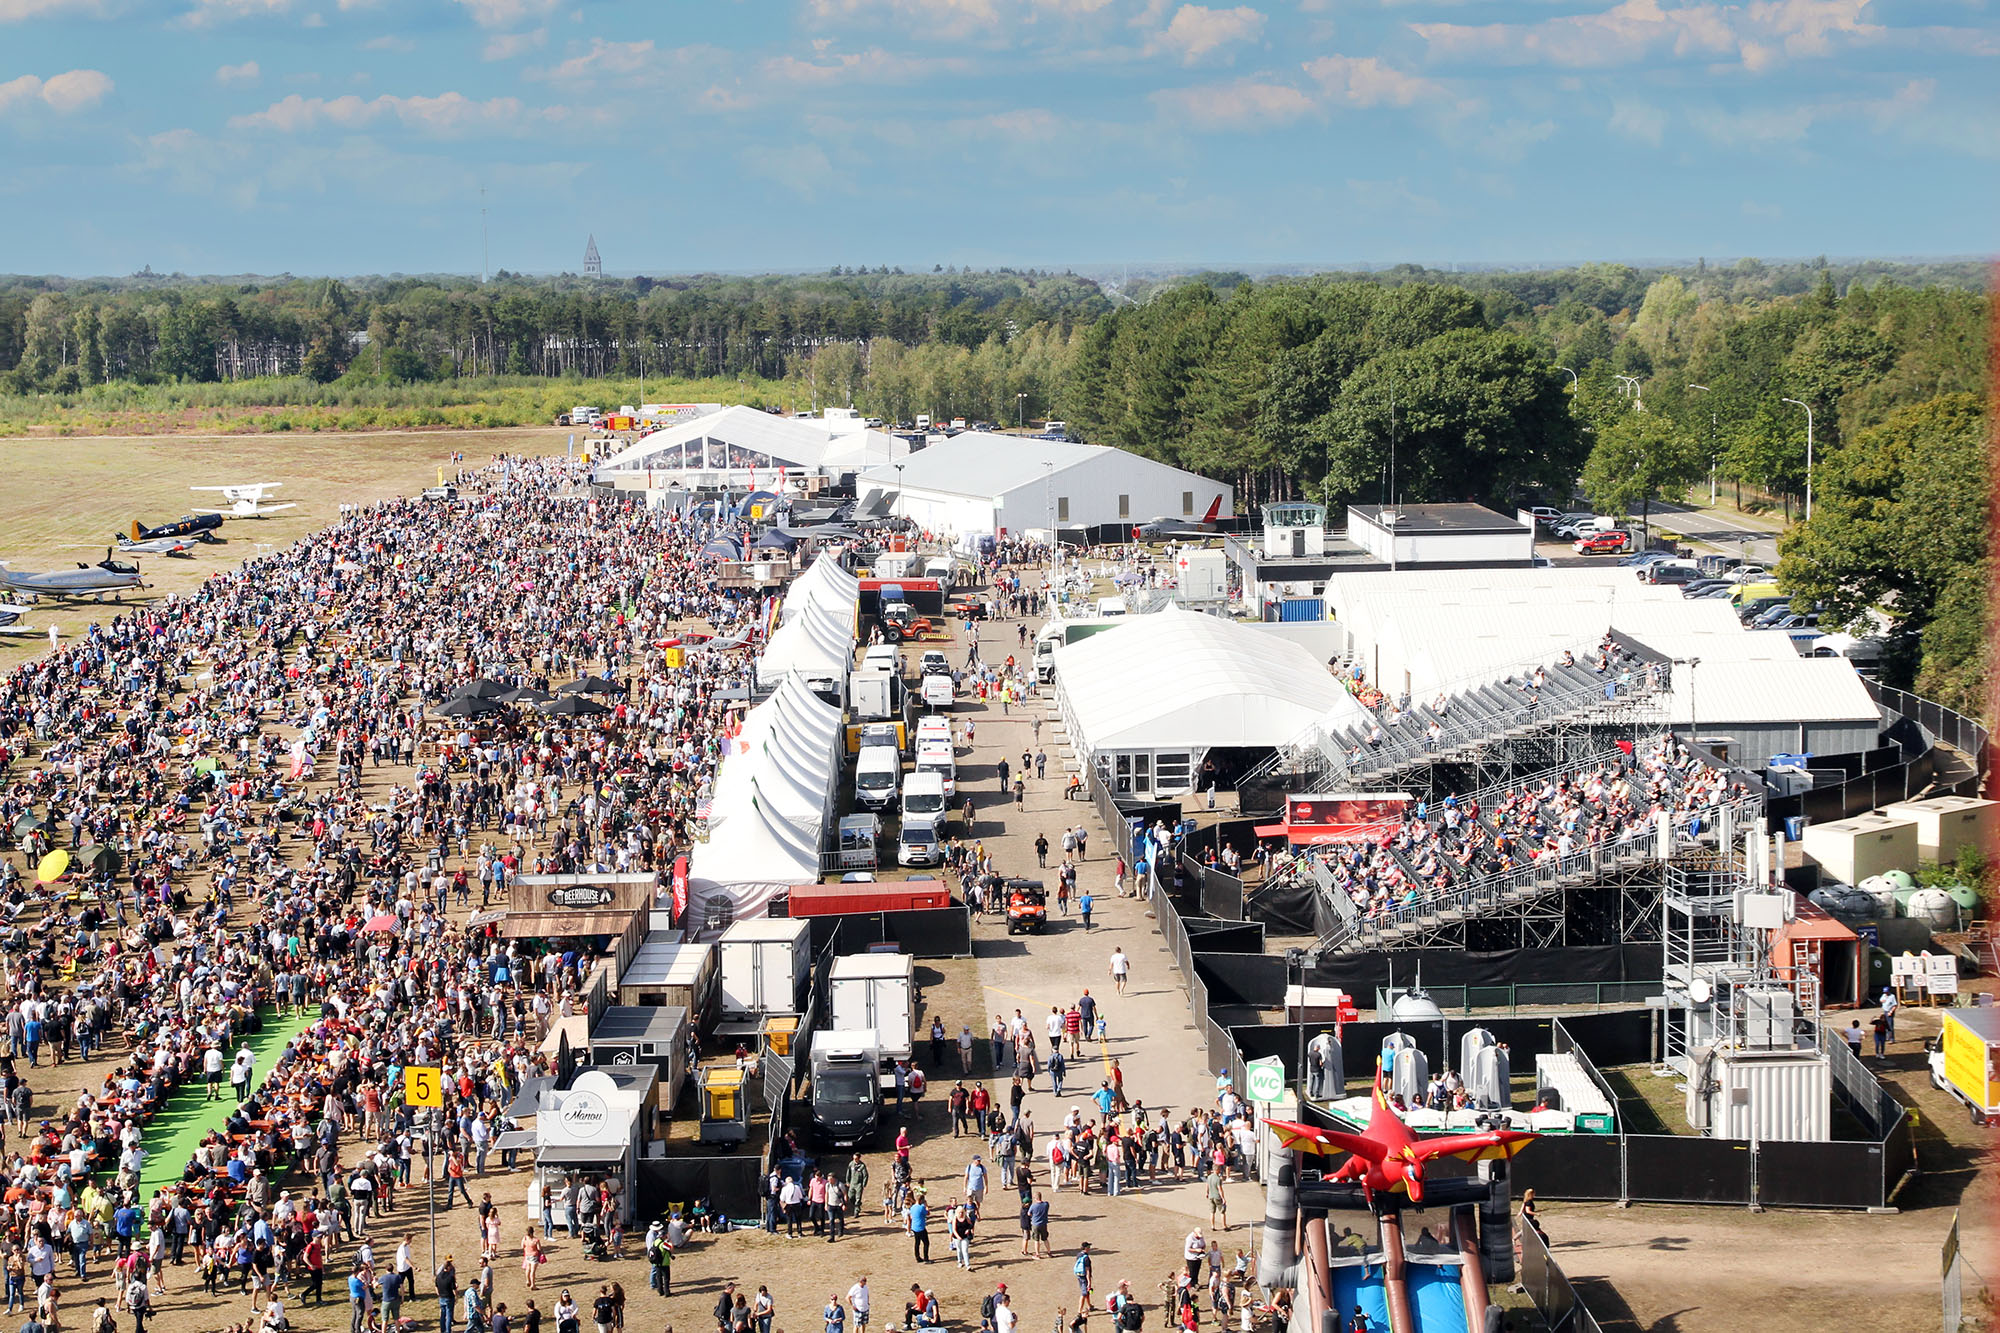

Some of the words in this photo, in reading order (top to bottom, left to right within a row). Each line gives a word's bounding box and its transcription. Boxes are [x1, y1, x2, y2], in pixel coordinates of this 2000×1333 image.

[754, 507, 760, 516] 3
[178, 522, 192, 532] FY
[564, 888, 599, 901] BEERHOUSE
[416, 1073, 430, 1100] 5
[1254, 1076, 1280, 1089] WC
[564, 1109, 602, 1121] Manou
